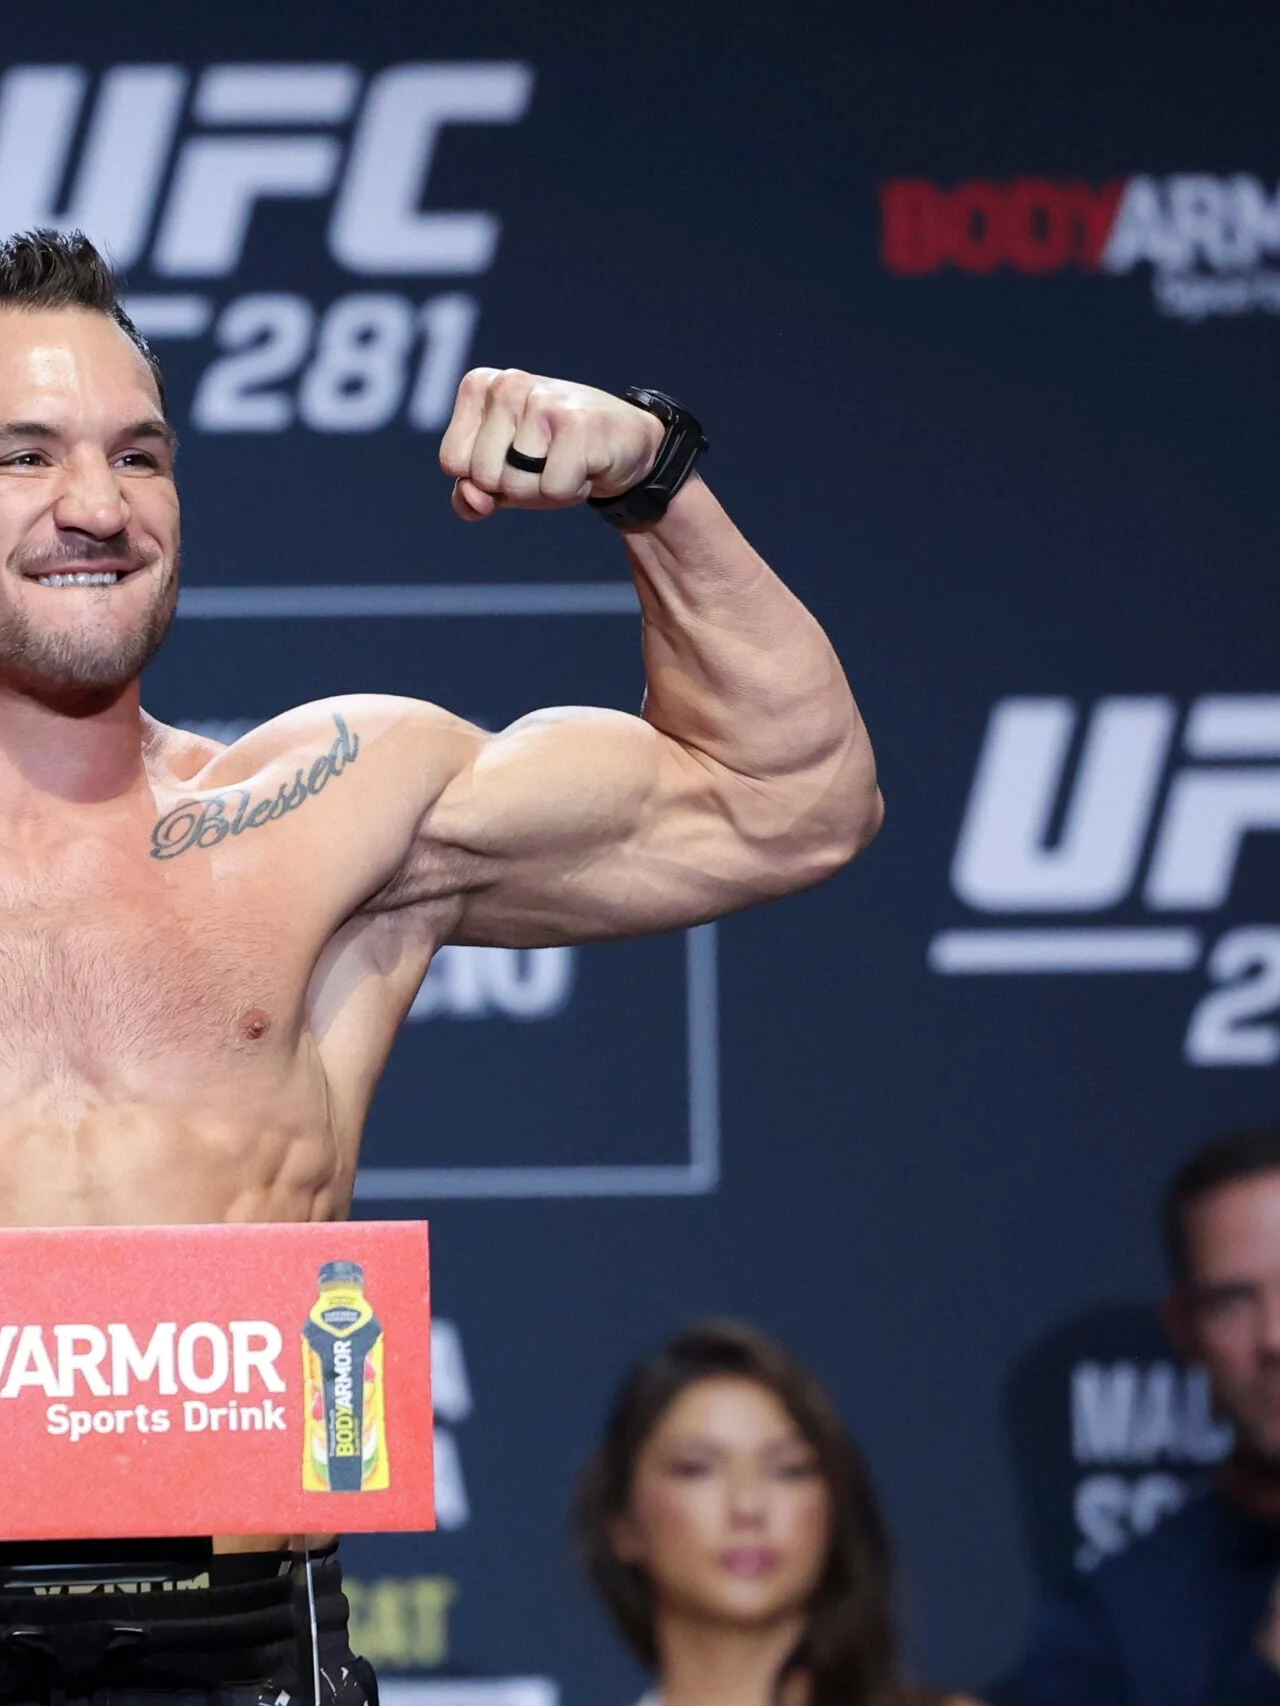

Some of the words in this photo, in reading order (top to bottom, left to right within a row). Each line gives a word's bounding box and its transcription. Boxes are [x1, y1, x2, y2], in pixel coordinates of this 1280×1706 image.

[190, 293, 478, 432] 281
[150, 711, 360, 860] Blessed
[47, 1403, 170, 1442] Sports
[183, 1400, 287, 1432] Drink
[333, 1340, 354, 1458] BODYARMOR
